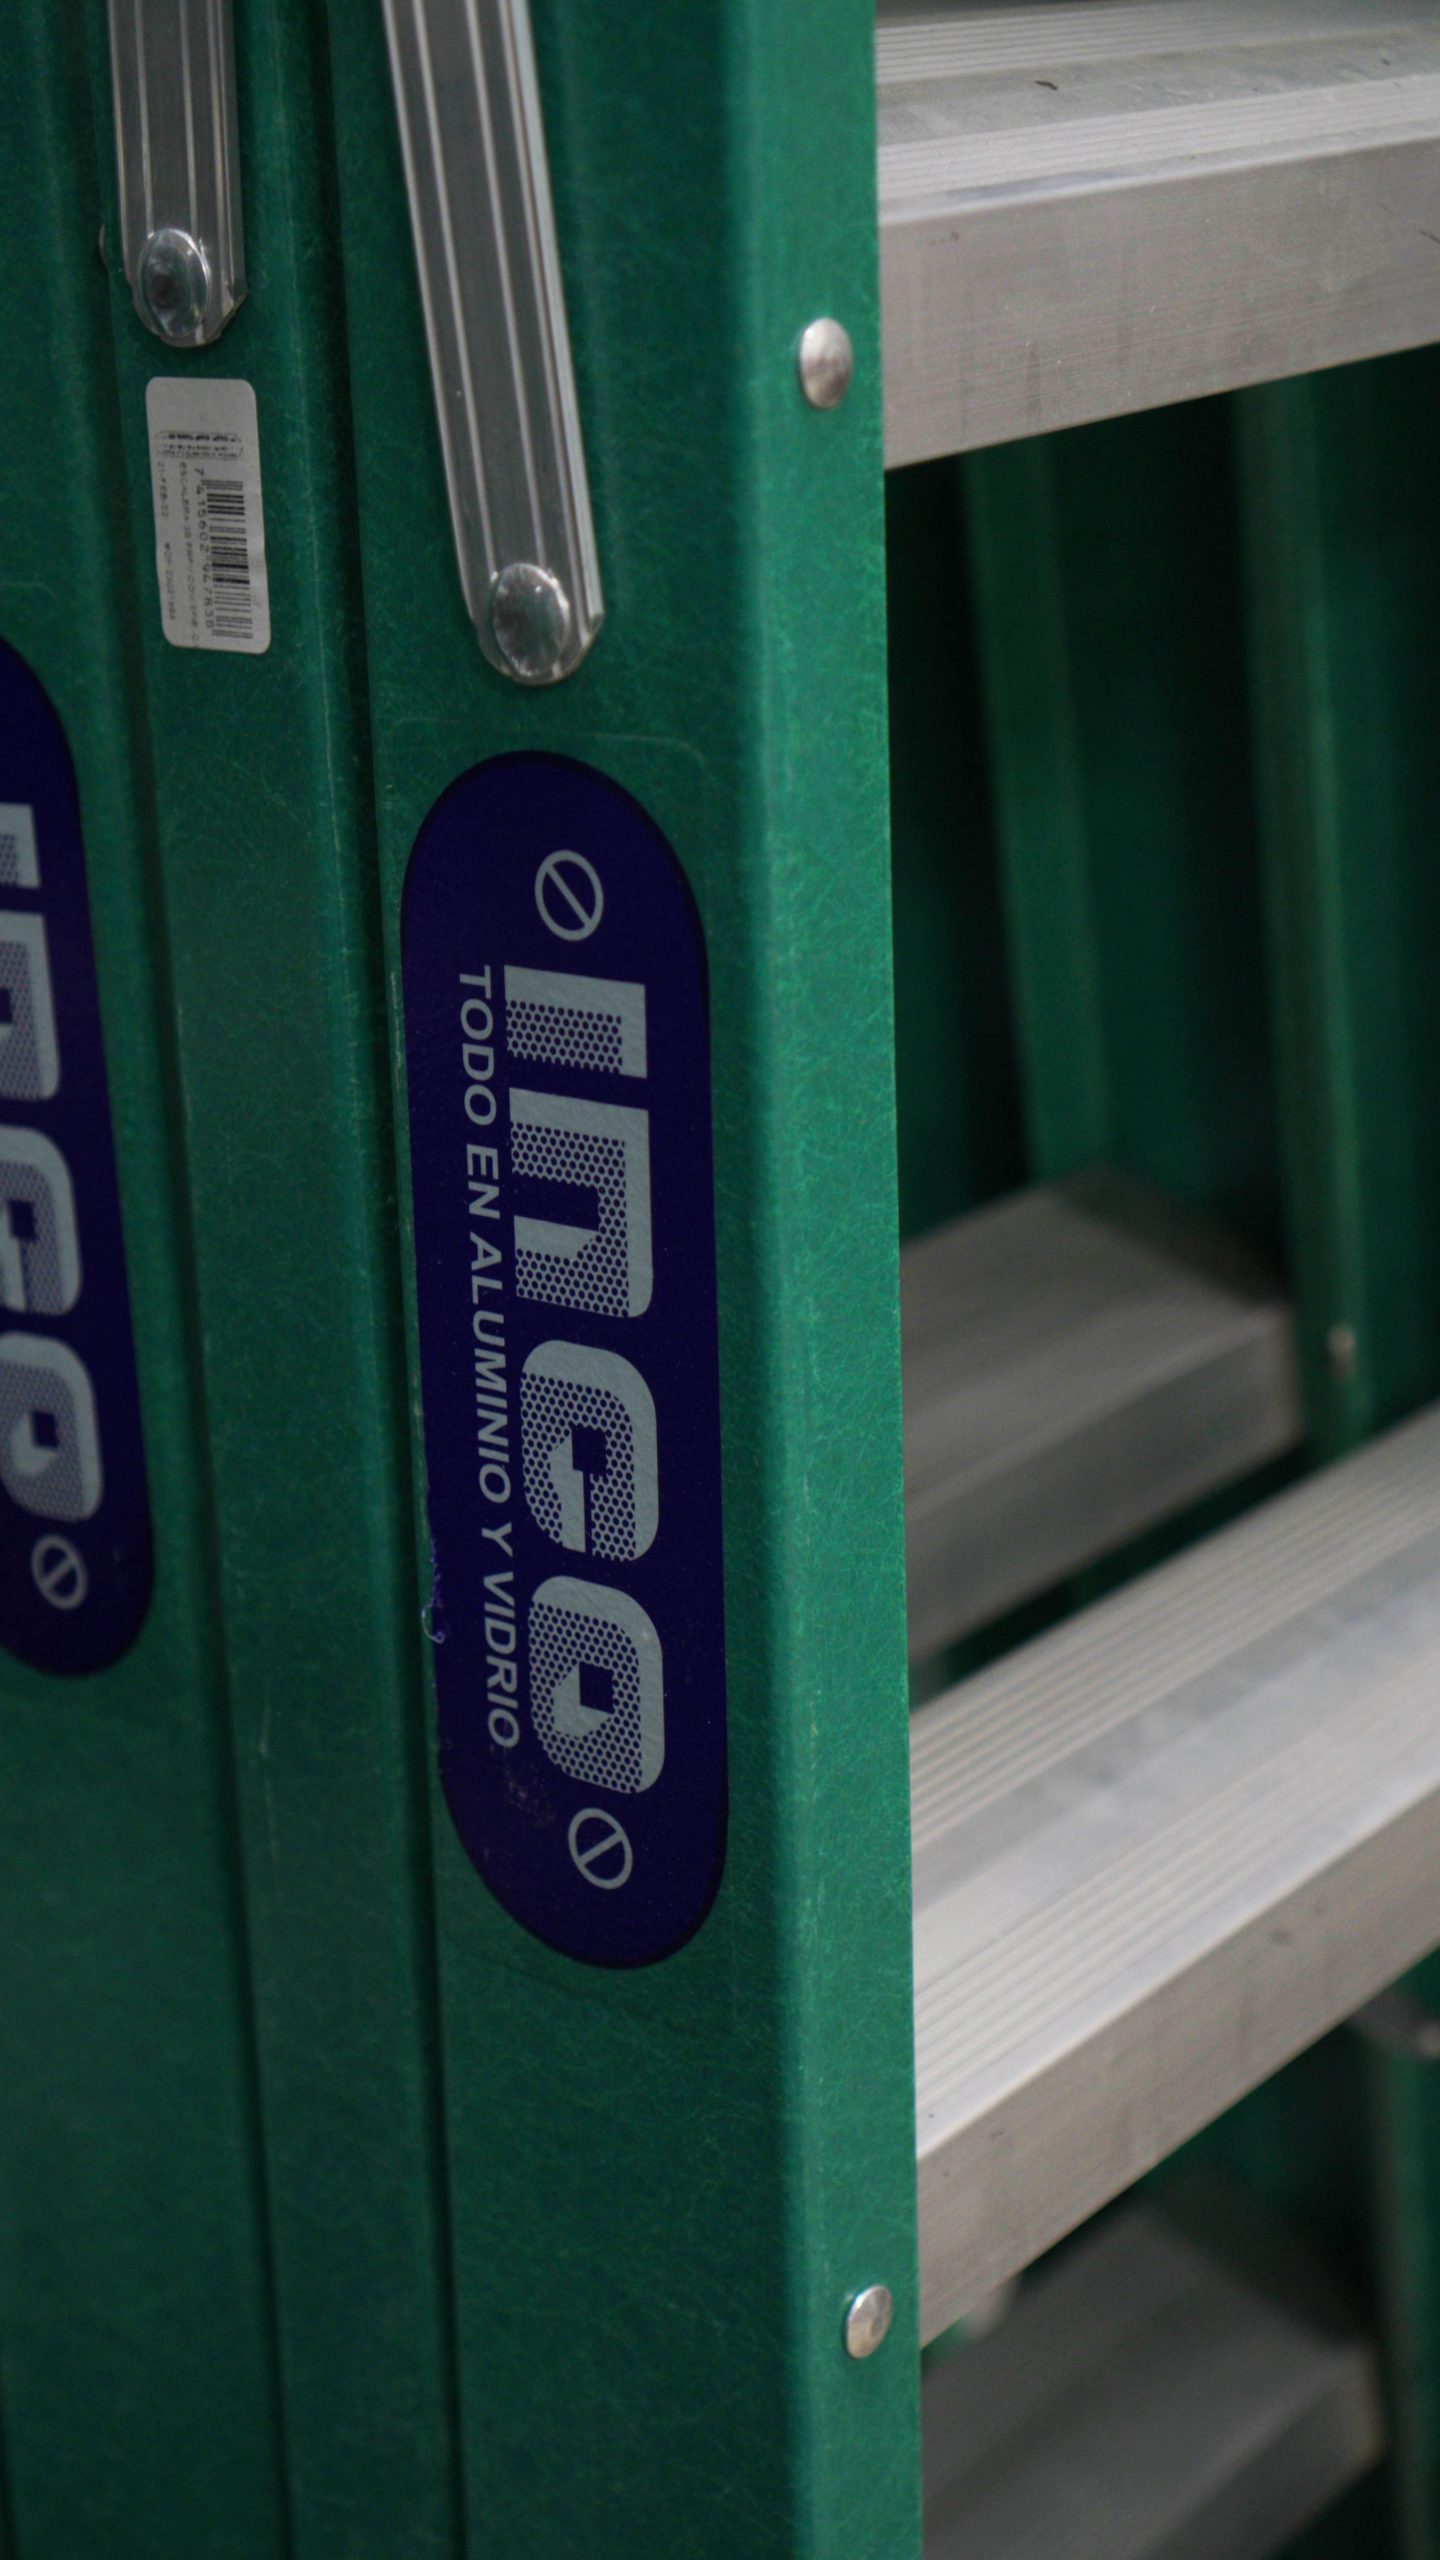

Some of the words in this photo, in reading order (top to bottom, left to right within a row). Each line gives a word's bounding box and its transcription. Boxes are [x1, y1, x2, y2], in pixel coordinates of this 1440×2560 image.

[459, 965, 497, 1126] TODO
[465, 1145, 501, 1218] EN
[469, 1231, 512, 1503] ALUMINIO
[503, 964, 666, 1794] INCO
[481, 1522, 514, 1557] Y
[482, 1571, 520, 1748] VIDRIO
